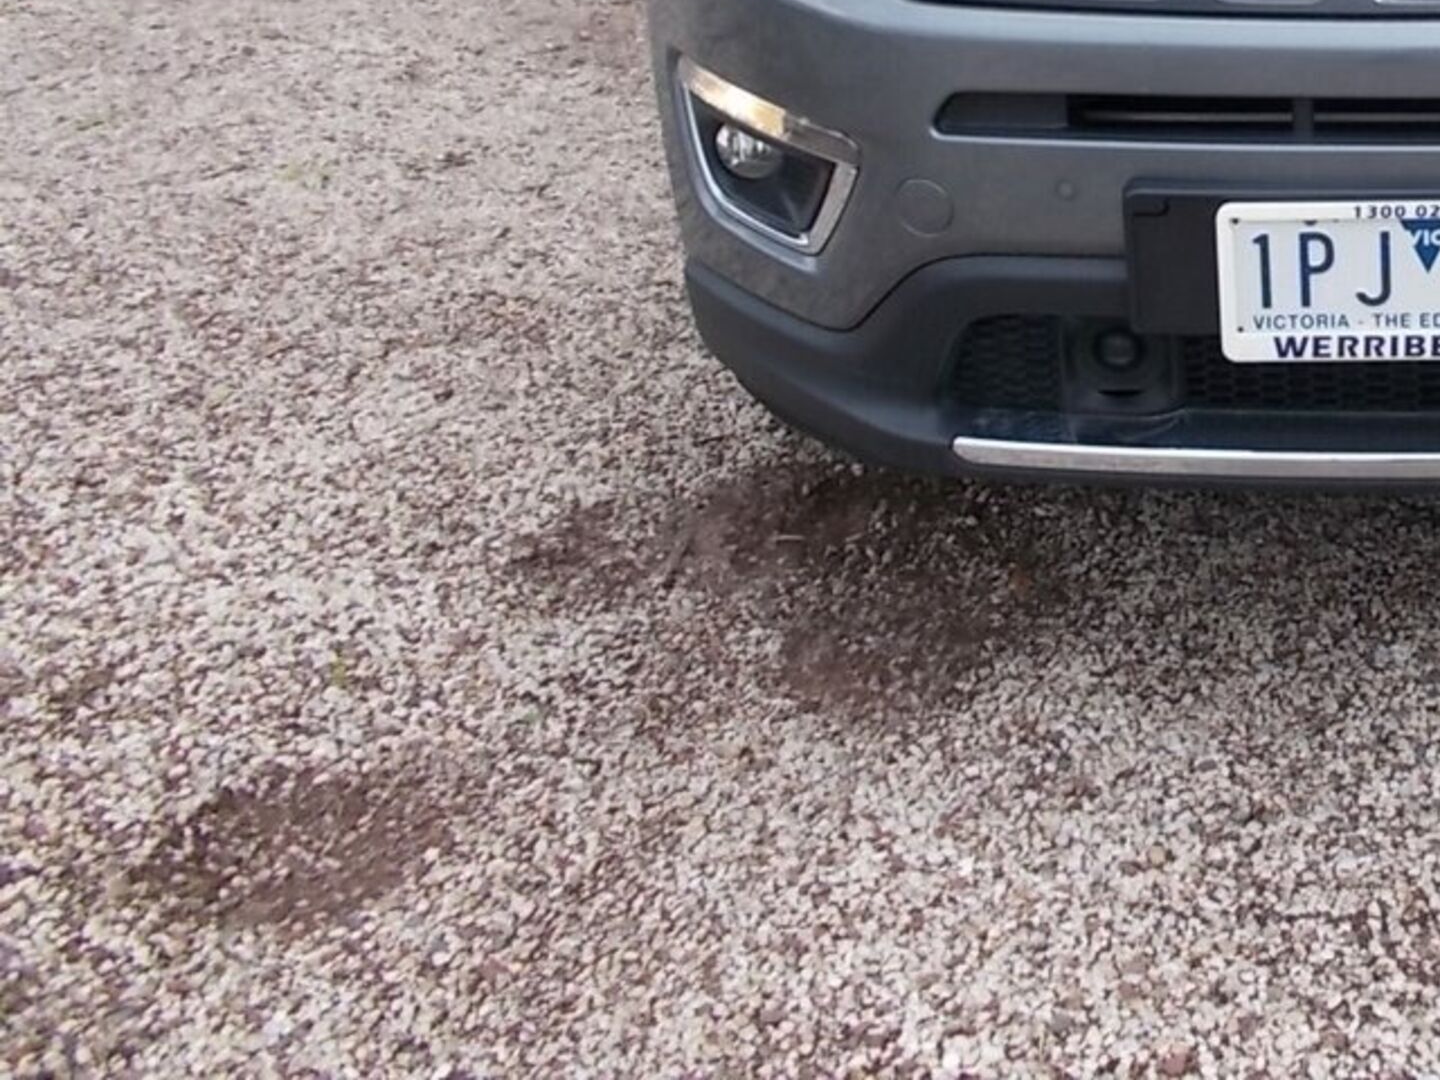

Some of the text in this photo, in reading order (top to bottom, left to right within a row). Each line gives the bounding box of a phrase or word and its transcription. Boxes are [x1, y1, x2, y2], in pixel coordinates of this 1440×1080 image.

[1353, 205, 1406, 219] 1300
[1252, 230, 1391, 309] 1PJ
[1252, 313, 1350, 331] VICTORIA
[1373, 312, 1411, 329] THE
